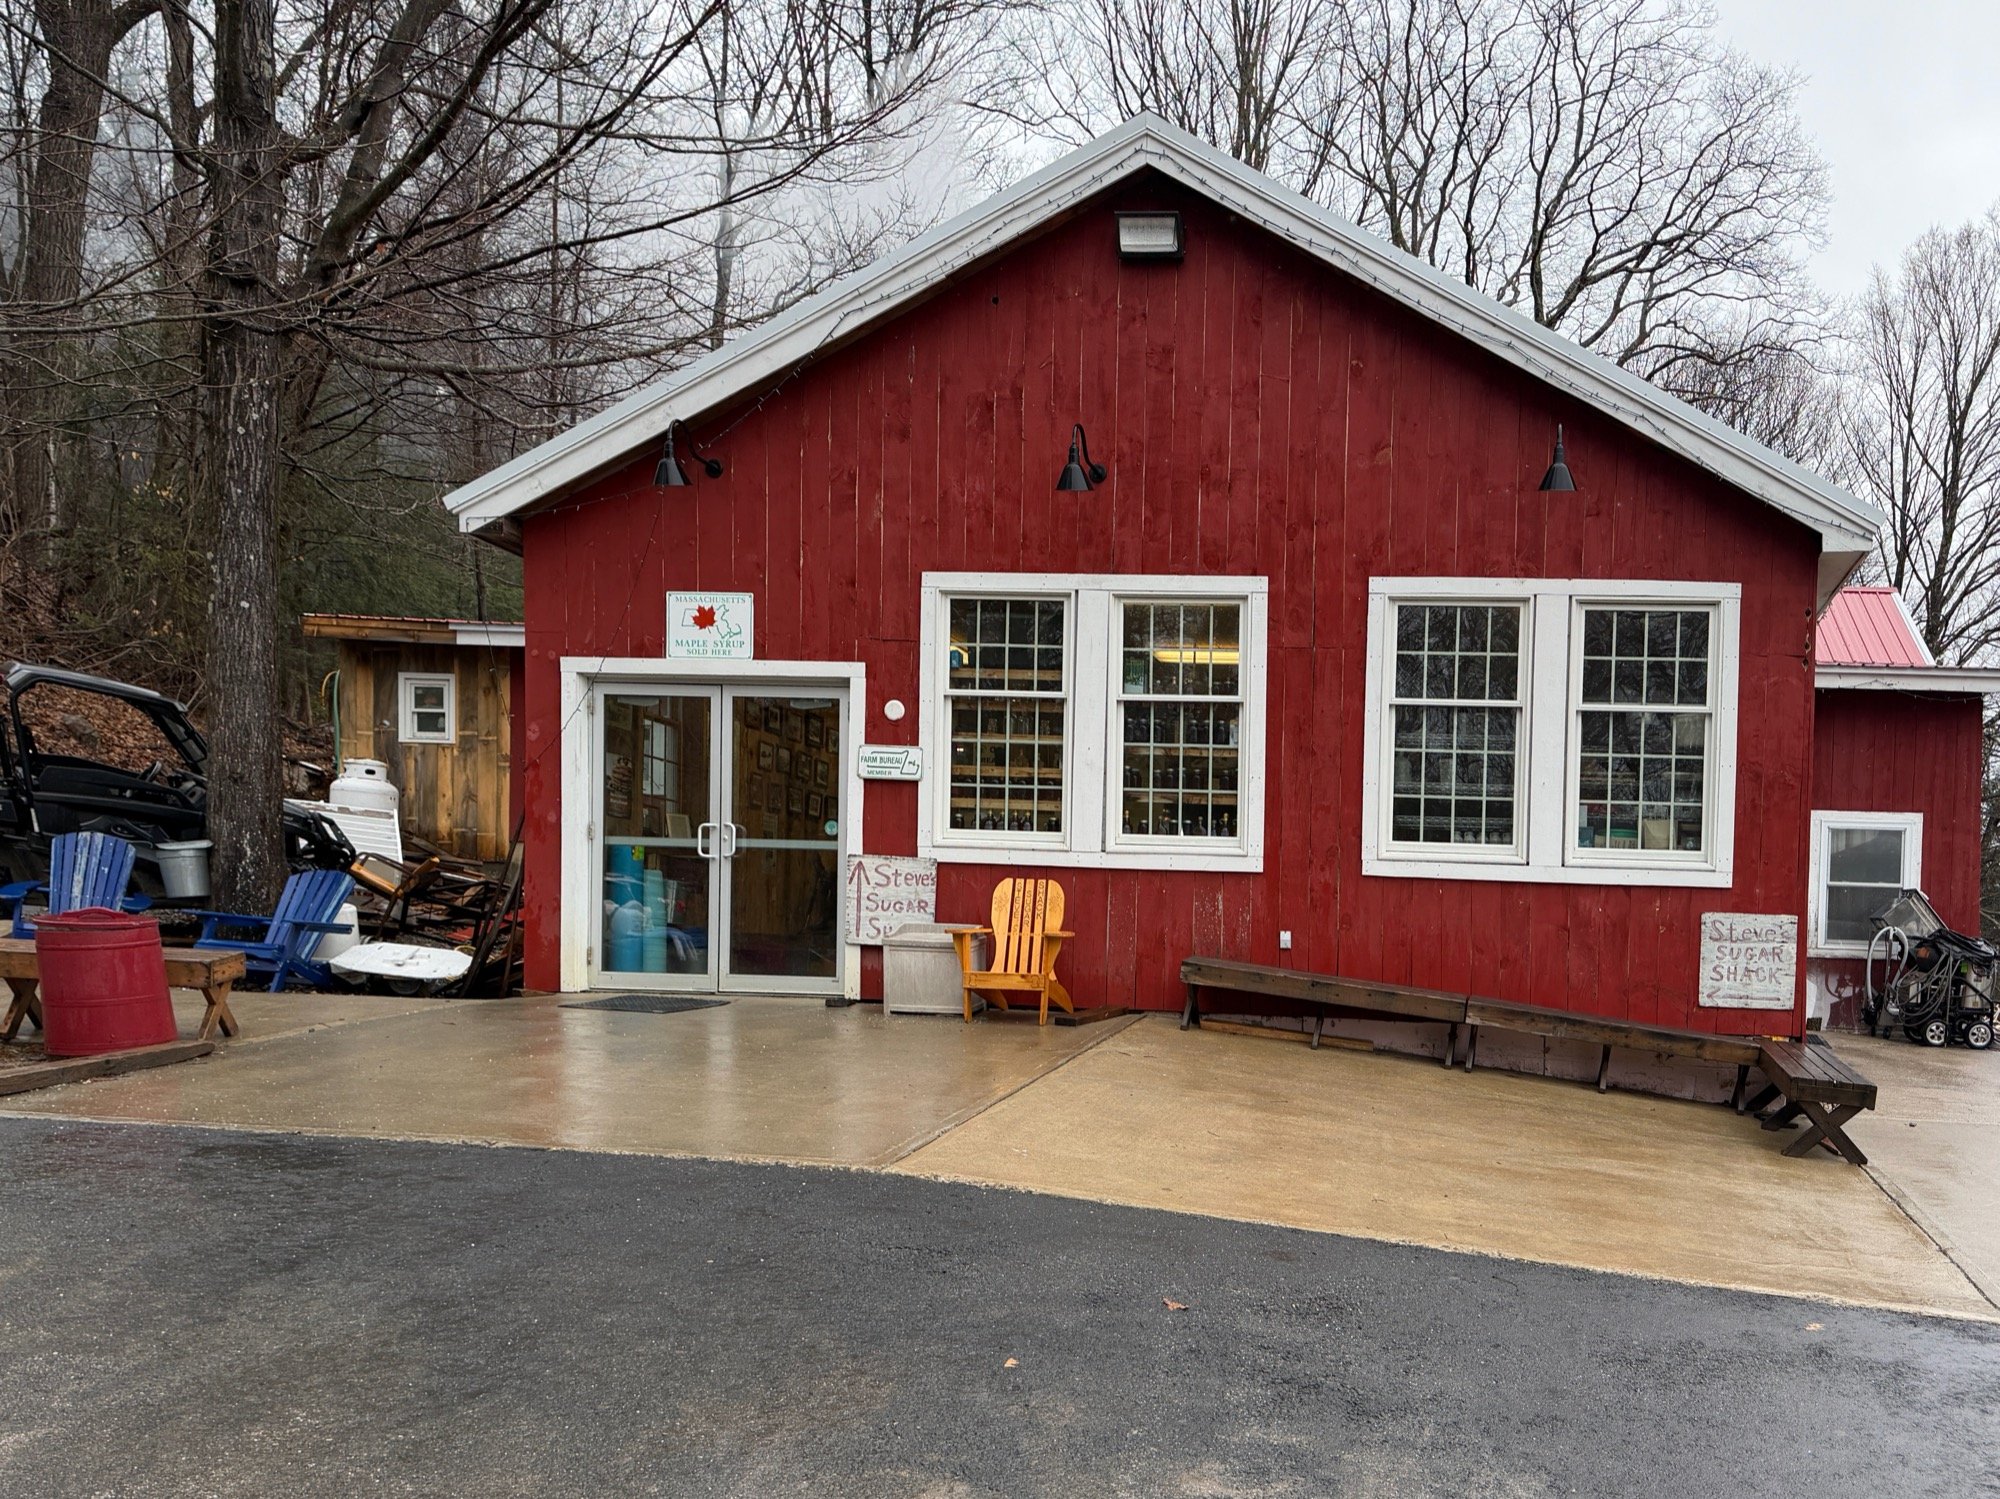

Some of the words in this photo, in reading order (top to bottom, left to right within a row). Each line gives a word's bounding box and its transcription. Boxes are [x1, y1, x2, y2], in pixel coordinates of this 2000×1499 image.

[675, 595, 746, 604] MASSACHUSETTS
[675, 639, 708, 648] MAPLE
[713, 640, 745, 648] SYRUP
[686, 648, 708, 656] SOLD
[711, 648, 733, 656] HERE
[860, 755, 878, 763] FARM
[879, 756, 903, 765] BUREAU
[874, 863, 936, 888] Steve's
[865, 892, 929, 914] SUGAR
[1715, 945, 1784, 963] SUGAR
[1709, 964, 1782, 985] SHACK
